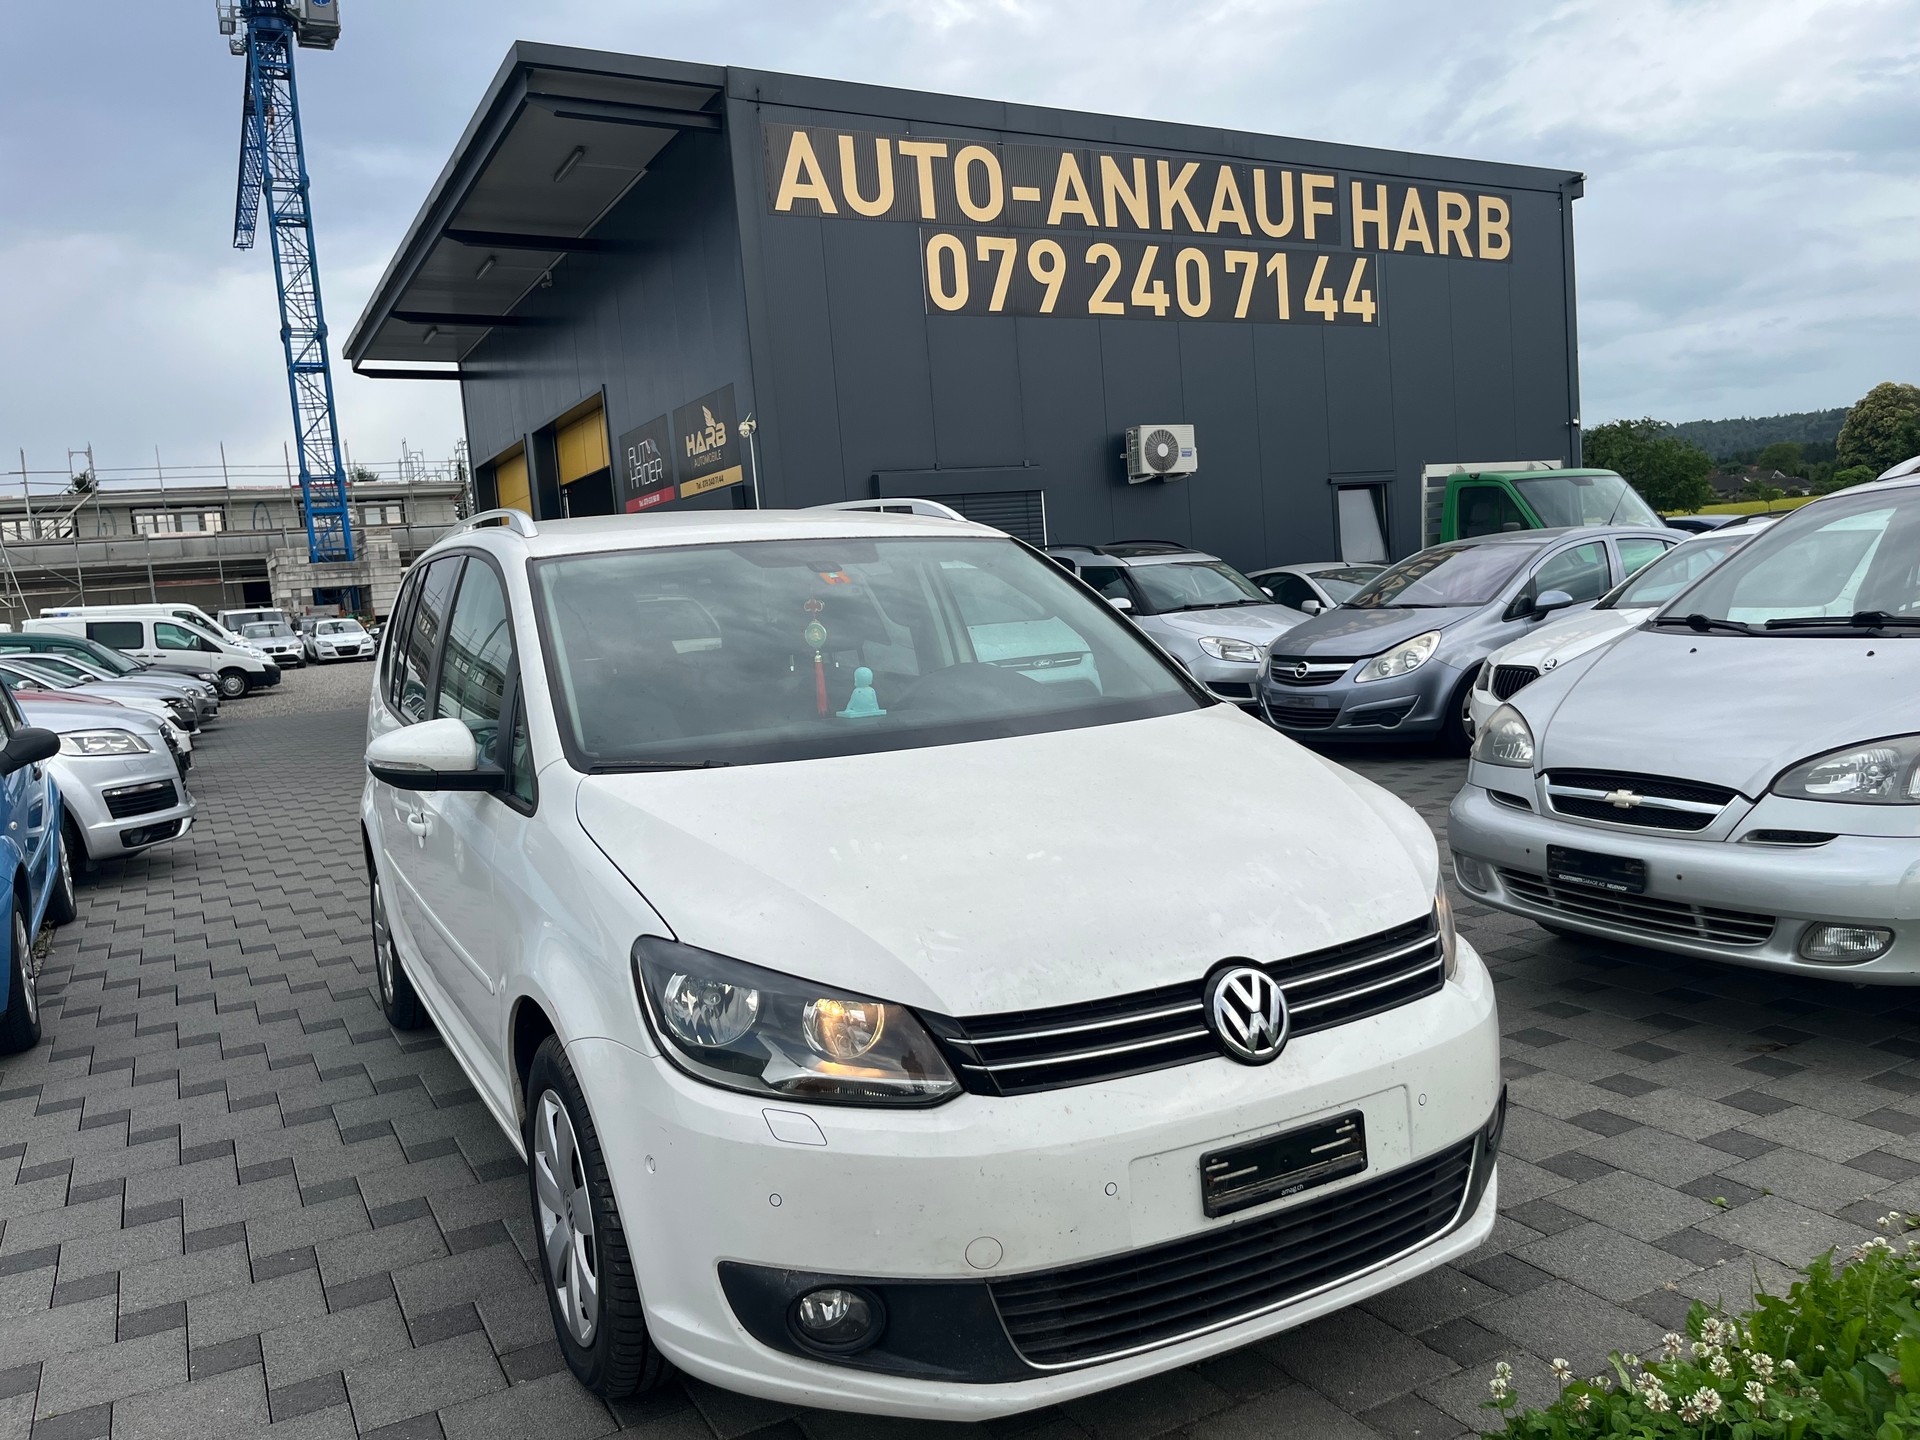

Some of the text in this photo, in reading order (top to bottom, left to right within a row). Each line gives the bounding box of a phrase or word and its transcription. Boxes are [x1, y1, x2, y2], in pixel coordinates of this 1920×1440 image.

[774, 131, 1511, 261] AUTO-ANKAUF HARB
[926, 233, 1376, 323] 079 240 71 44
[686, 422, 727, 457] HARB
[630, 457, 663, 489] HAIDER
